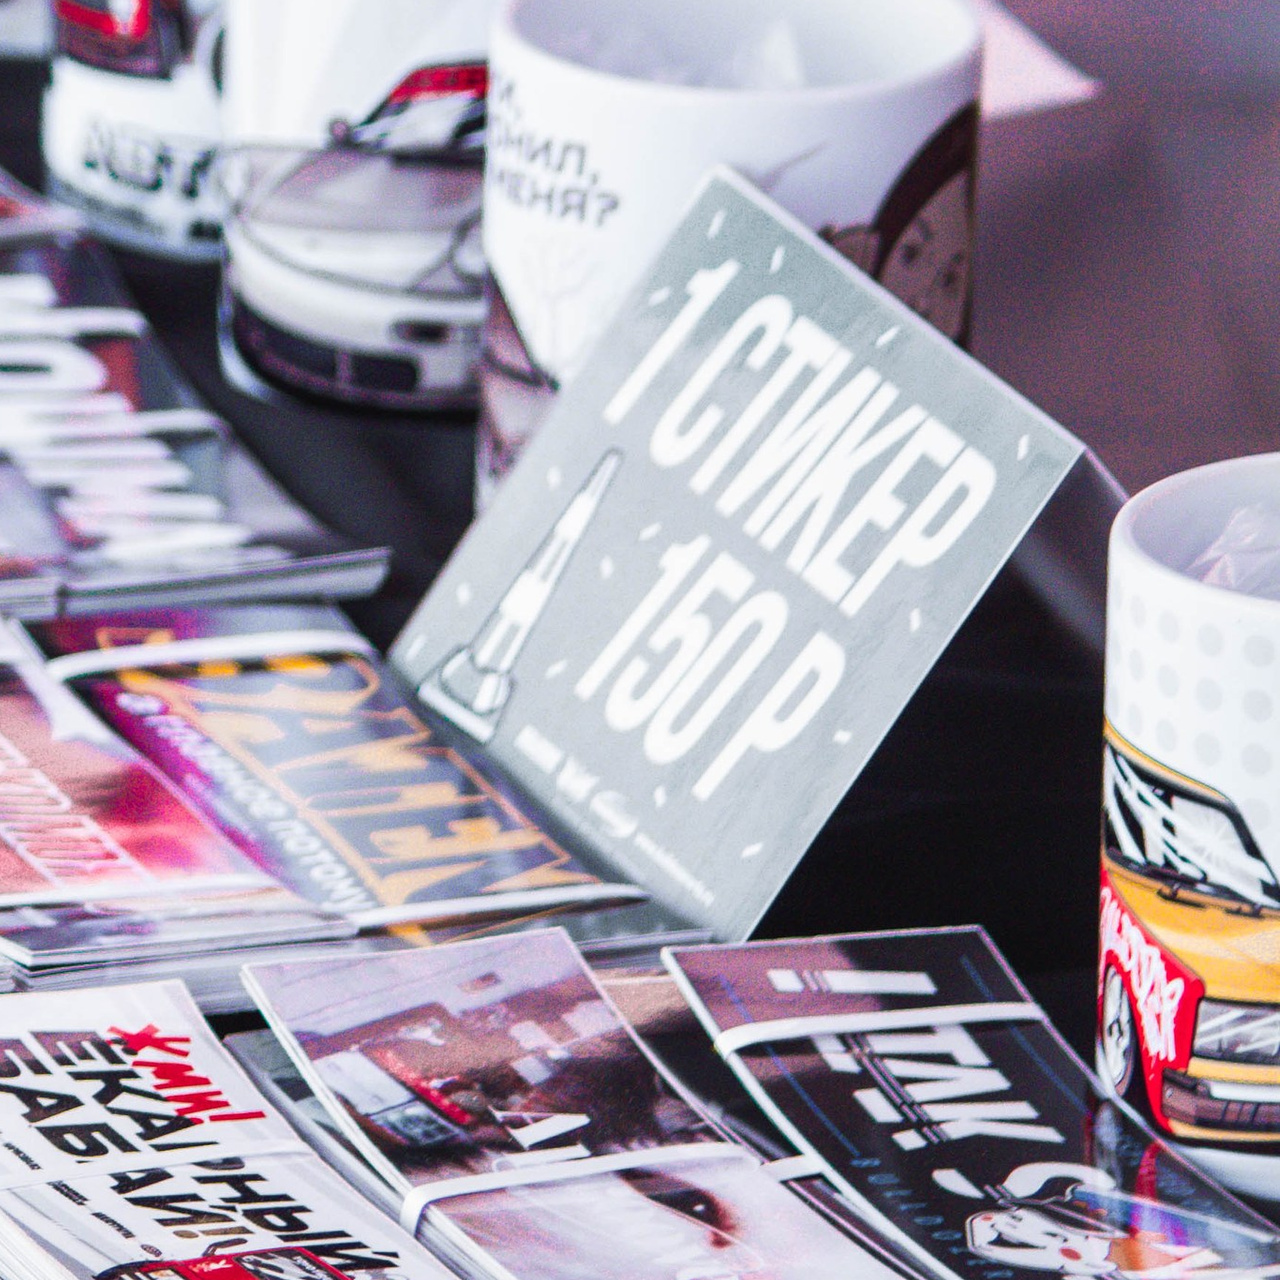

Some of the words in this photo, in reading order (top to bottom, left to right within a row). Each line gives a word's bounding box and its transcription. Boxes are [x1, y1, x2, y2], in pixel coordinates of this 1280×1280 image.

[601, 256, 740, 424] 1
[649, 293, 997, 617] СТИКЕР
[574, 534, 789, 768] 150
[691, 631, 845, 802] Р
[106, 1023, 266, 1126] ЖМИ!
